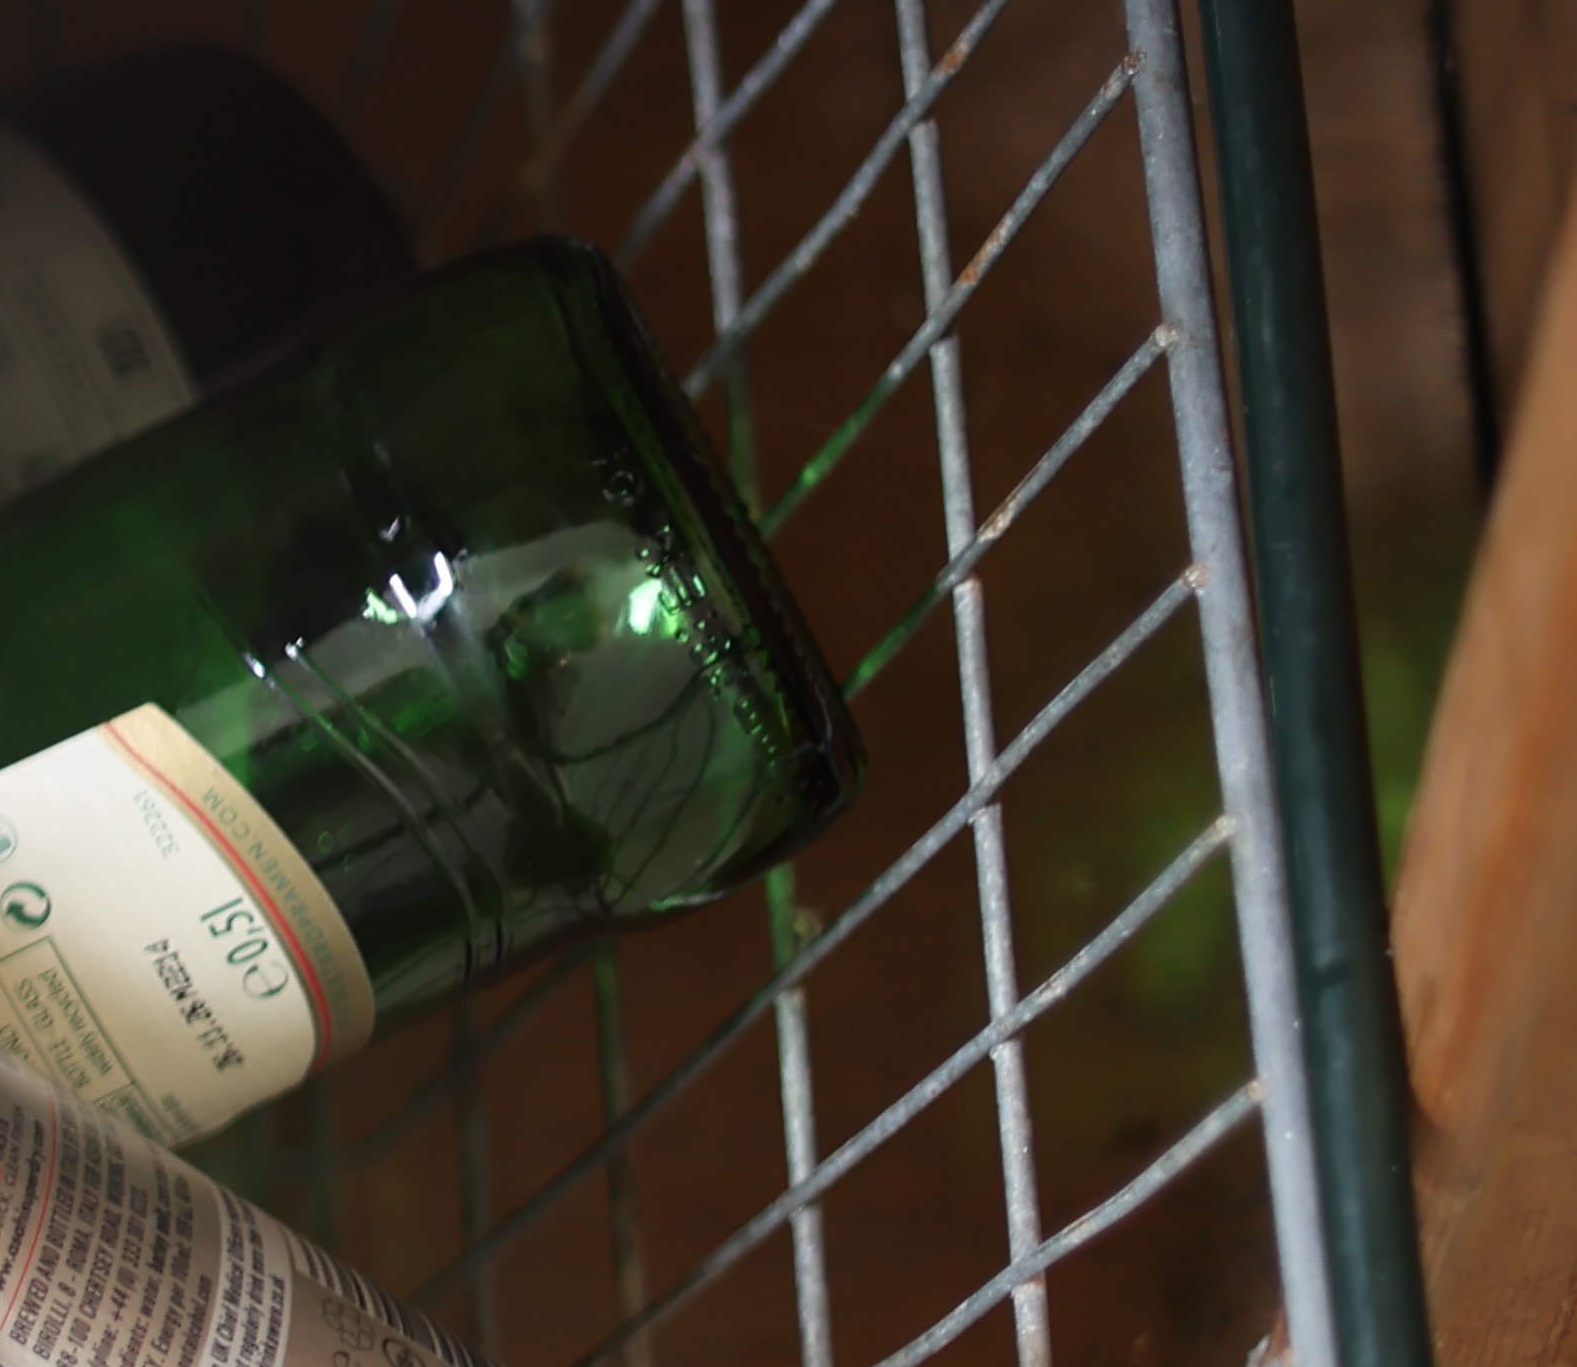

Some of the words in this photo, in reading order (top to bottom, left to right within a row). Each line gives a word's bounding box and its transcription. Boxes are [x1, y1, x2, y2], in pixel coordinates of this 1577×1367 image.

[200, 897, 268, 966] 0,5l
[13, 976, 54, 1030] GLASS
[36, 967, 85, 1032] recycled
[47, 1037, 90, 1096] BOTTLE
[78, 1031, 112, 1076] widely
[45, 1188, 74, 1249] BOTTLED
[35, 1245, 60, 1281] AND
[78, 1246, 112, 1319] CHERTSEY
[9, 1277, 48, 1345] BREWED
[110, 1286, 129, 1322] +44
[215, 1303, 238, 1342] Chief
[210, 1337, 231, 1364] UK
